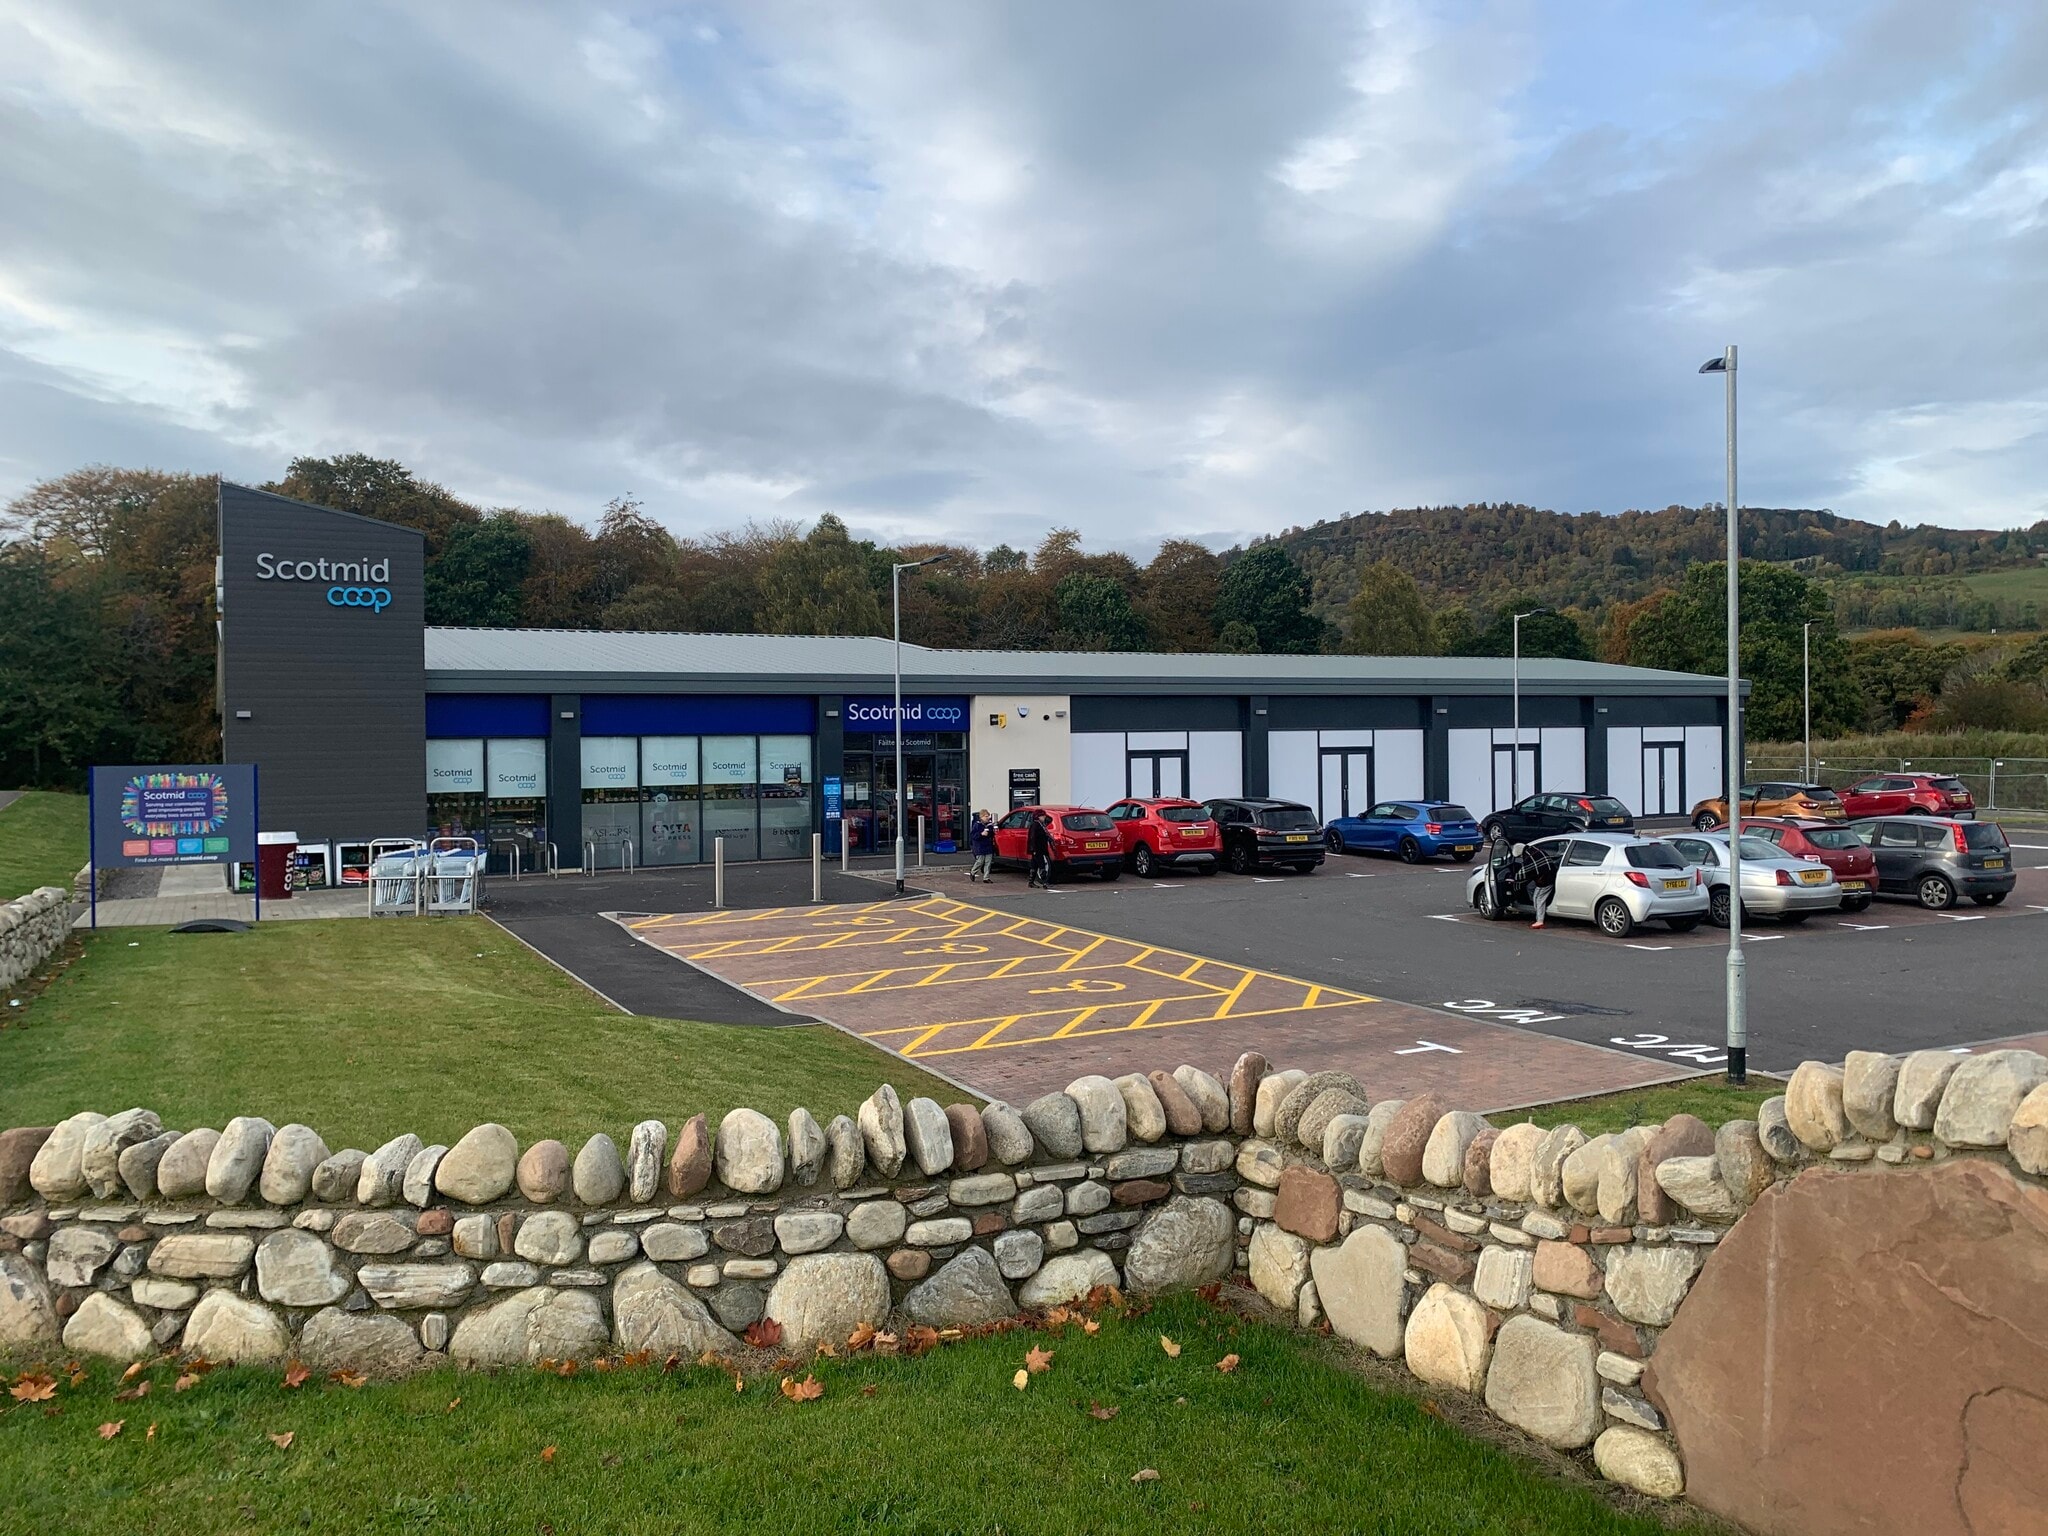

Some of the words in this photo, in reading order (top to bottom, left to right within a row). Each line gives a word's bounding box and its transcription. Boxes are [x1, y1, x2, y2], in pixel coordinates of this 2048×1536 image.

[256, 552, 389, 583] Scotmid
[326, 586, 392, 614] coop
[848, 703, 922, 720] Scotmid
[926, 707, 961, 723] coop
[590, 765, 626, 774] Scotmid
[652, 763, 688, 771] Scotmid
[712, 762, 746, 770] Scotmid
[770, 761, 802, 769] Scotmid
[433, 768, 472, 777] Scotmid
[498, 773, 537, 782] Scotmid
[143, 791, 185, 800] Scotmid
[187, 792, 208, 800] coop
[284, 851, 295, 891] COSTA
